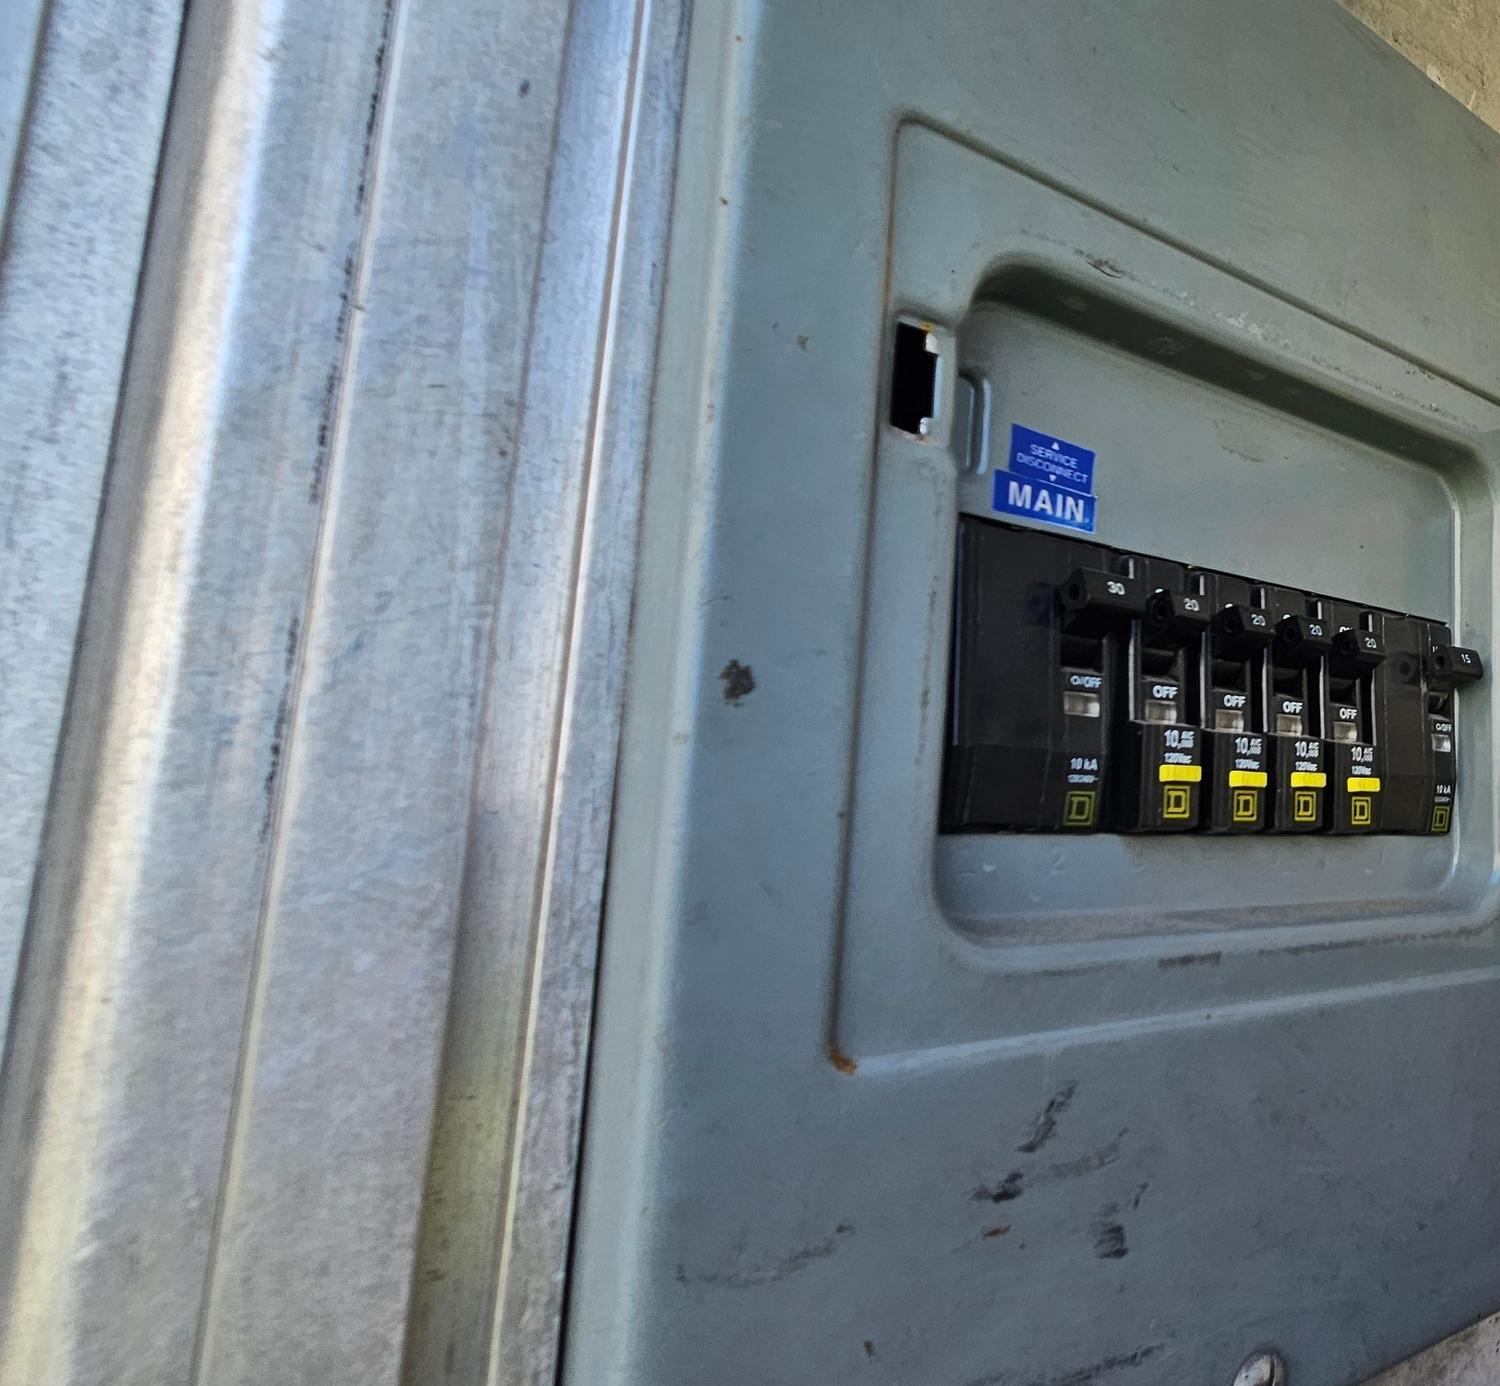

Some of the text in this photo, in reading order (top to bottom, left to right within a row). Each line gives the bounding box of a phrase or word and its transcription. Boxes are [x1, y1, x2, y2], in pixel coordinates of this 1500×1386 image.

[1030, 444, 1078, 469] SERVICE
[1016, 452, 1088, 483] DISCONNECT
[1008, 480, 1084, 523] MAIN
[1107, 581, 1126, 595] 30
[1183, 598, 1200, 611] 20
[1251, 614, 1266, 626] 20
[1309, 624, 1322, 635] 20
[1365, 637, 1377, 648] 20
[1461, 654, 1472, 664] 15
[1153, 685, 1178, 699] OFF
[1223, 694, 1246, 707] OFF
[1283, 701, 1303, 713] OFF
[1339, 708, 1358, 720] OFF
